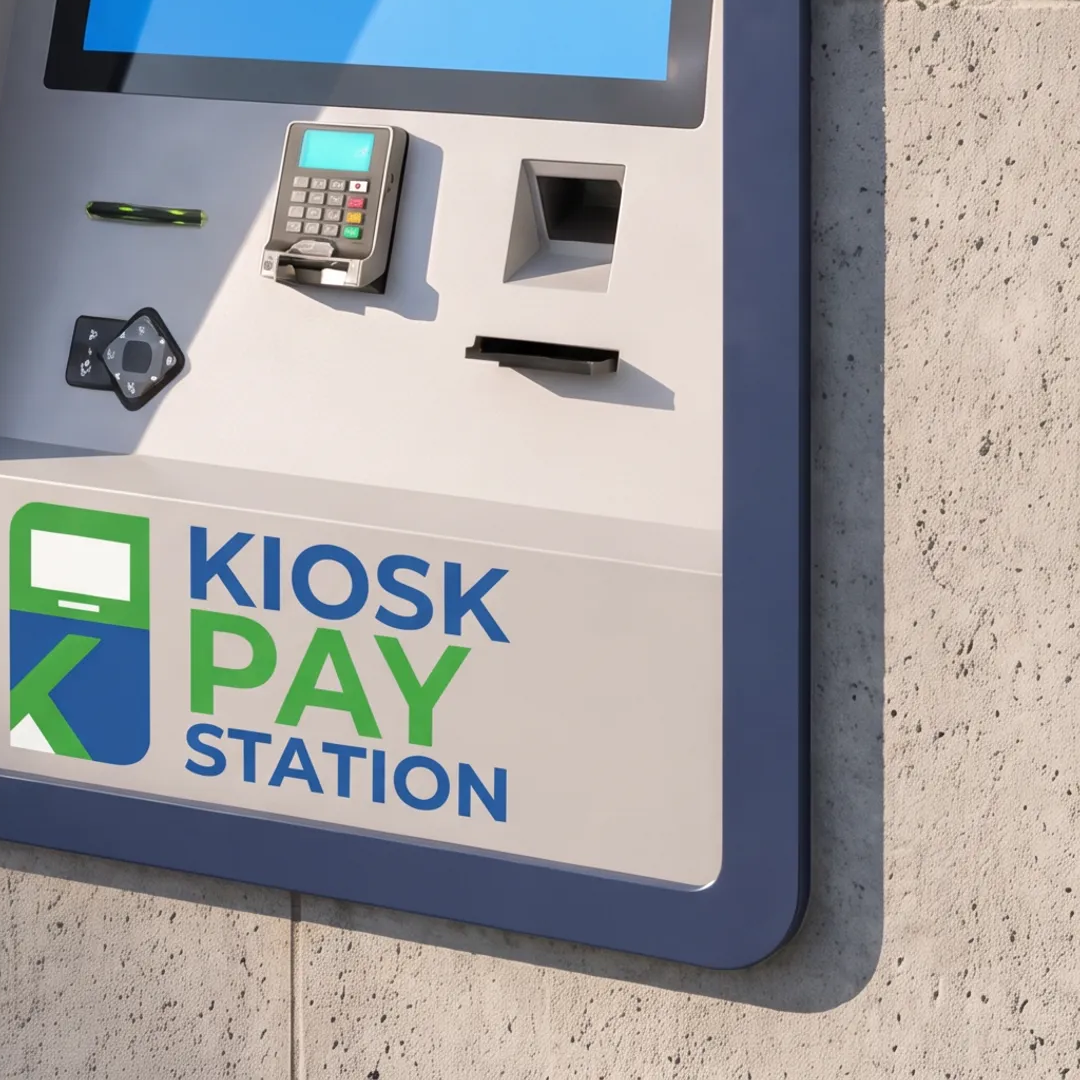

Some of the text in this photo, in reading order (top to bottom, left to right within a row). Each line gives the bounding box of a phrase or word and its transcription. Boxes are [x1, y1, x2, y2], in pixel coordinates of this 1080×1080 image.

[190, 525, 510, 643] KIOSK
[190, 608, 472, 747] PAY
[185, 723, 507, 822] STATION
